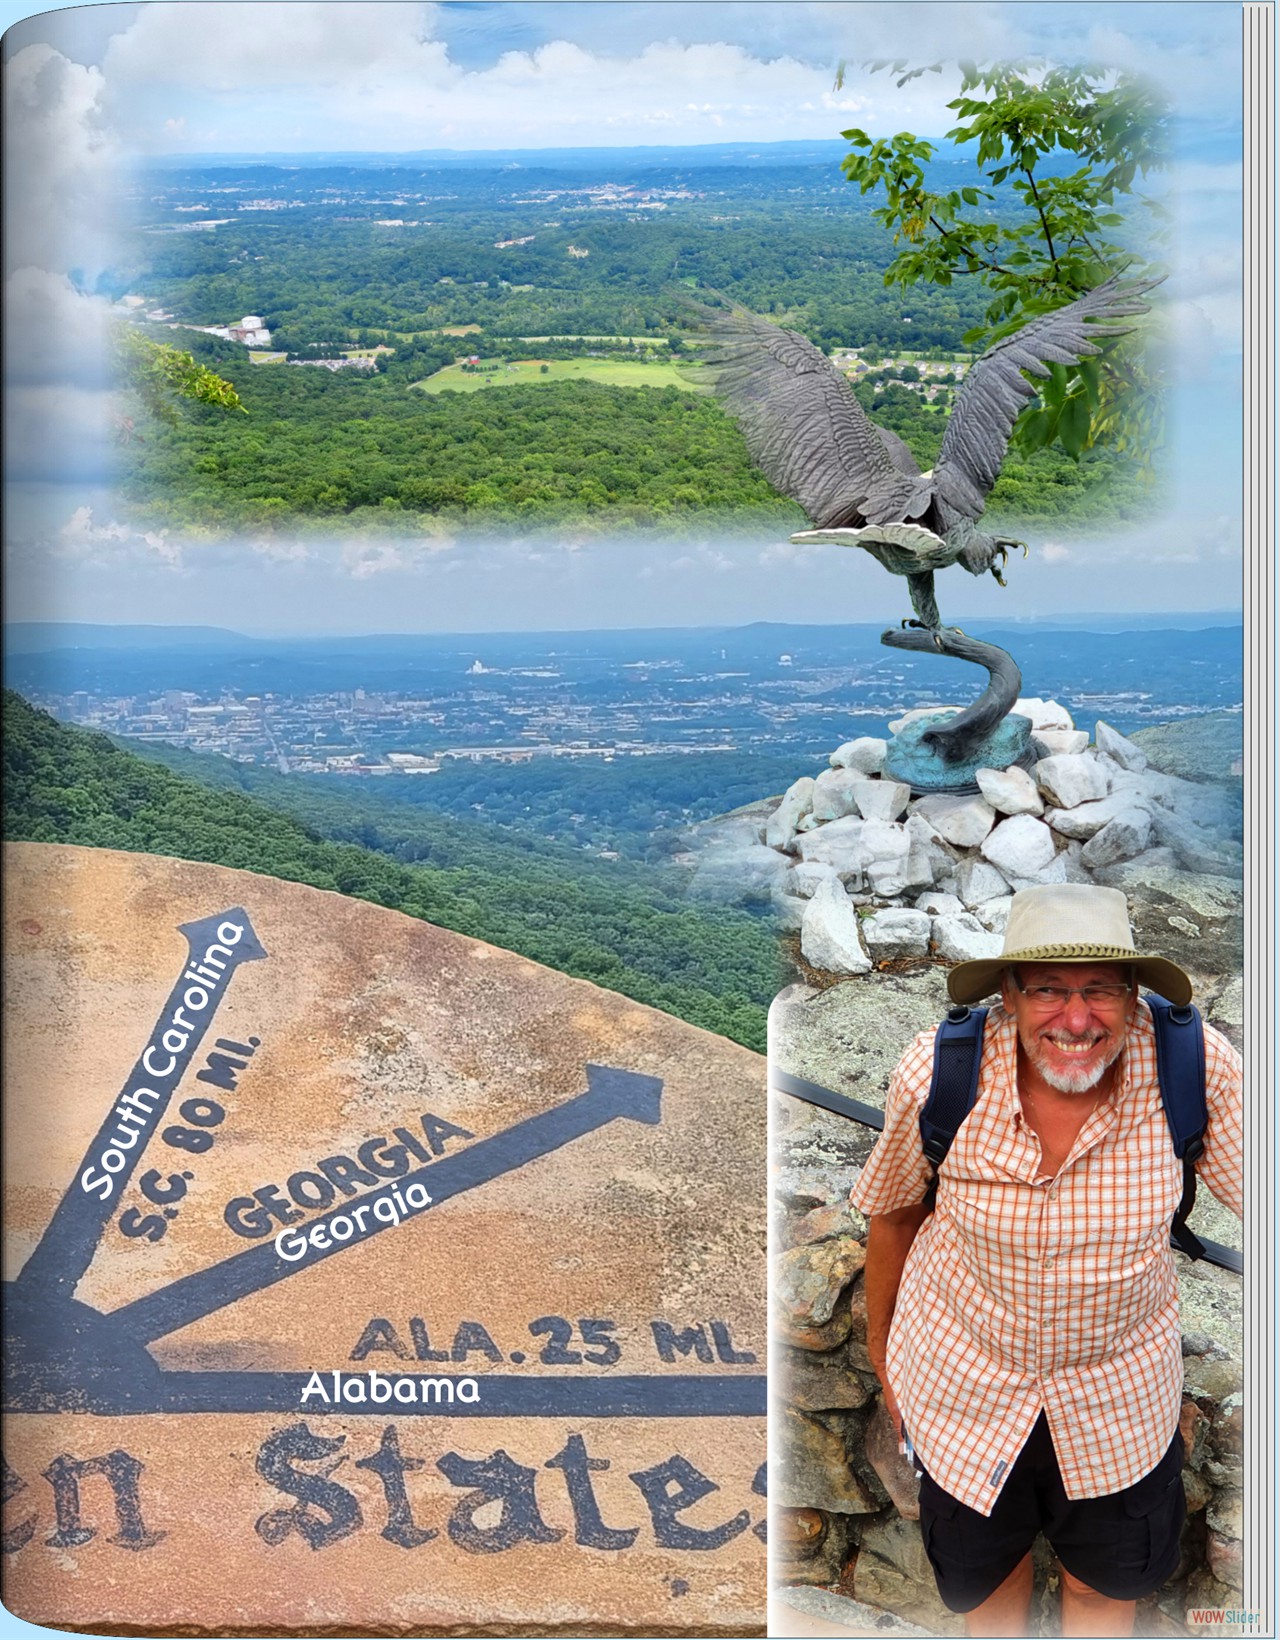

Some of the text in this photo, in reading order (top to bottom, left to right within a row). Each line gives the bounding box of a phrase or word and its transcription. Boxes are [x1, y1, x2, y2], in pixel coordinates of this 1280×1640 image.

[161, 1097, 226, 1154] 80
[195, 1036, 261, 1092] MI.
[224, 1112, 475, 1239] GEORGIA
